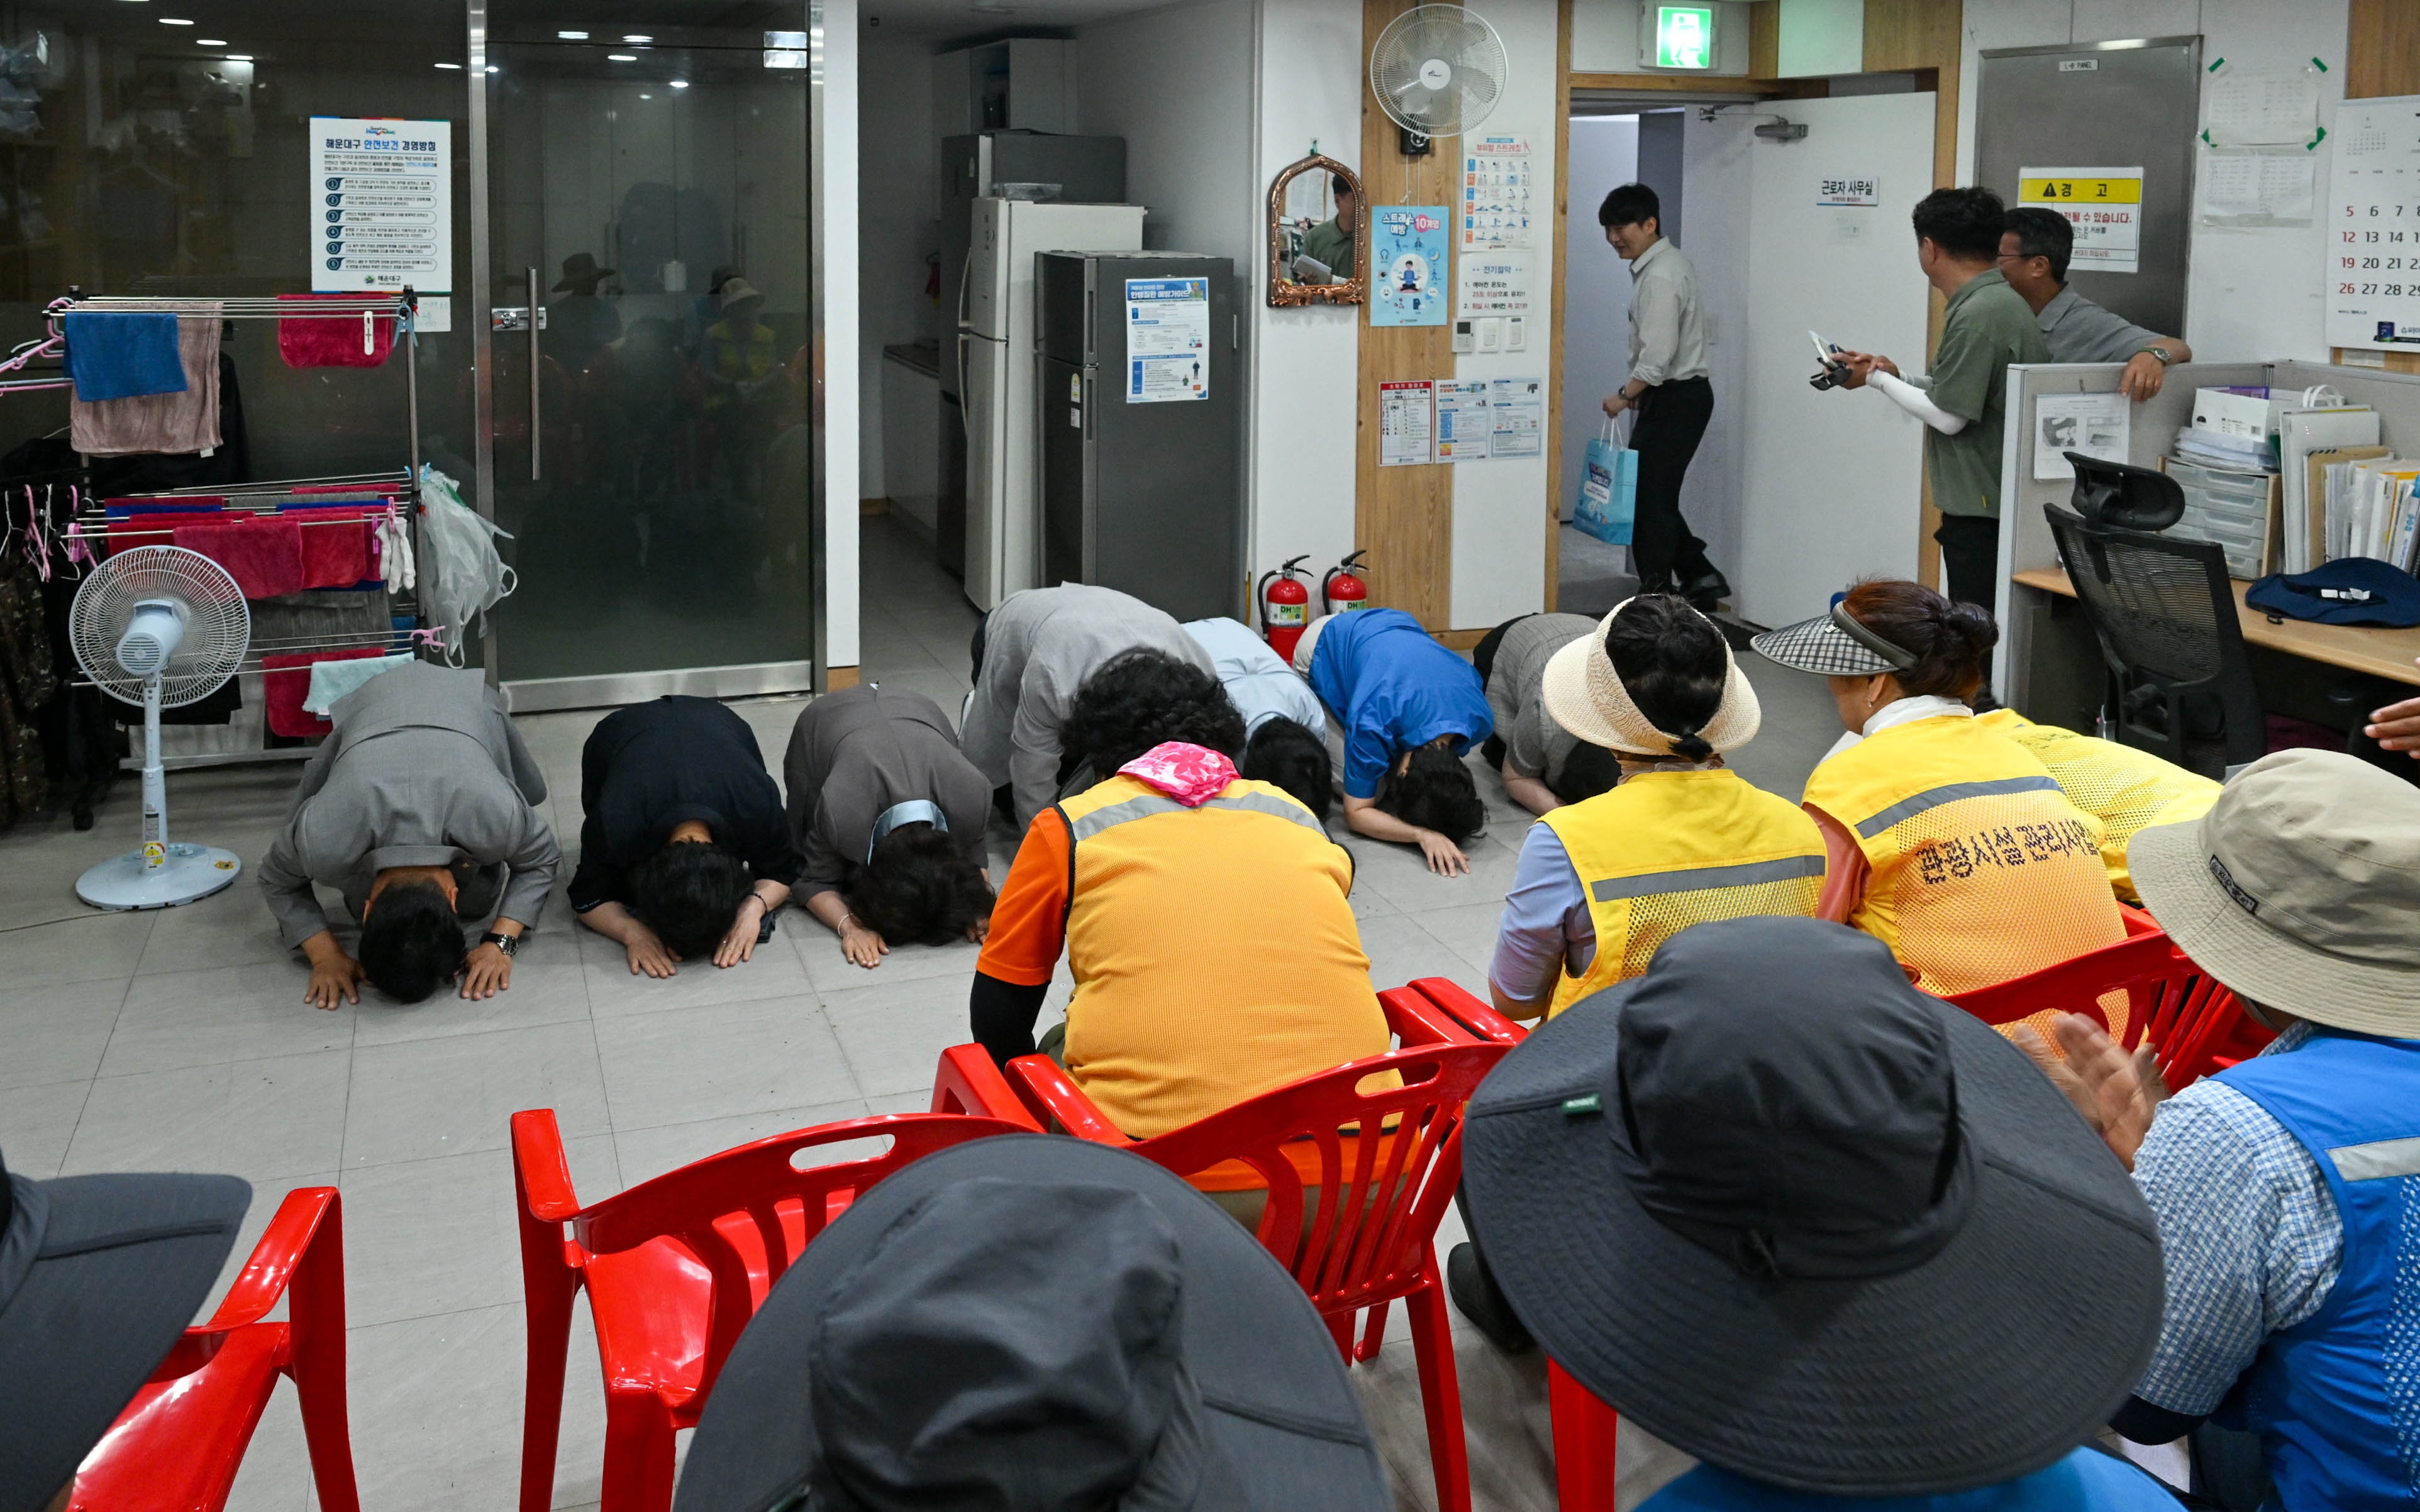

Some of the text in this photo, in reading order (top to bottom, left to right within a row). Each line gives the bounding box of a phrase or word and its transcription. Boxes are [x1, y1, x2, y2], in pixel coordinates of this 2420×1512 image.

[326, 138, 436, 151] 해운대구 안전보건 경영방침
[1496, 144, 1521, 152] 스트레칭
[1822, 180, 1873, 196] 근로자 사무실
[2062, 183, 2107, 197] 경 고
[2058, 211, 2132, 223] 전될 수 있습니다.
[2346, 206, 2403, 217] 5 6 7
[1382, 212, 1414, 224] 스트레스
[1390, 224, 1406, 235] 예방
[2342, 231, 2356, 243] 12
[2365, 231, 2379, 243] 13
[2389, 231, 2403, 243] 14
[2341, 257, 2420, 270] 19 20 21 2
[1484, 266, 1511, 274] 전기절약
[2339, 283, 2355, 294] 26
[2362, 284, 2378, 295] 27
[2384, 284, 2401, 296] 28
